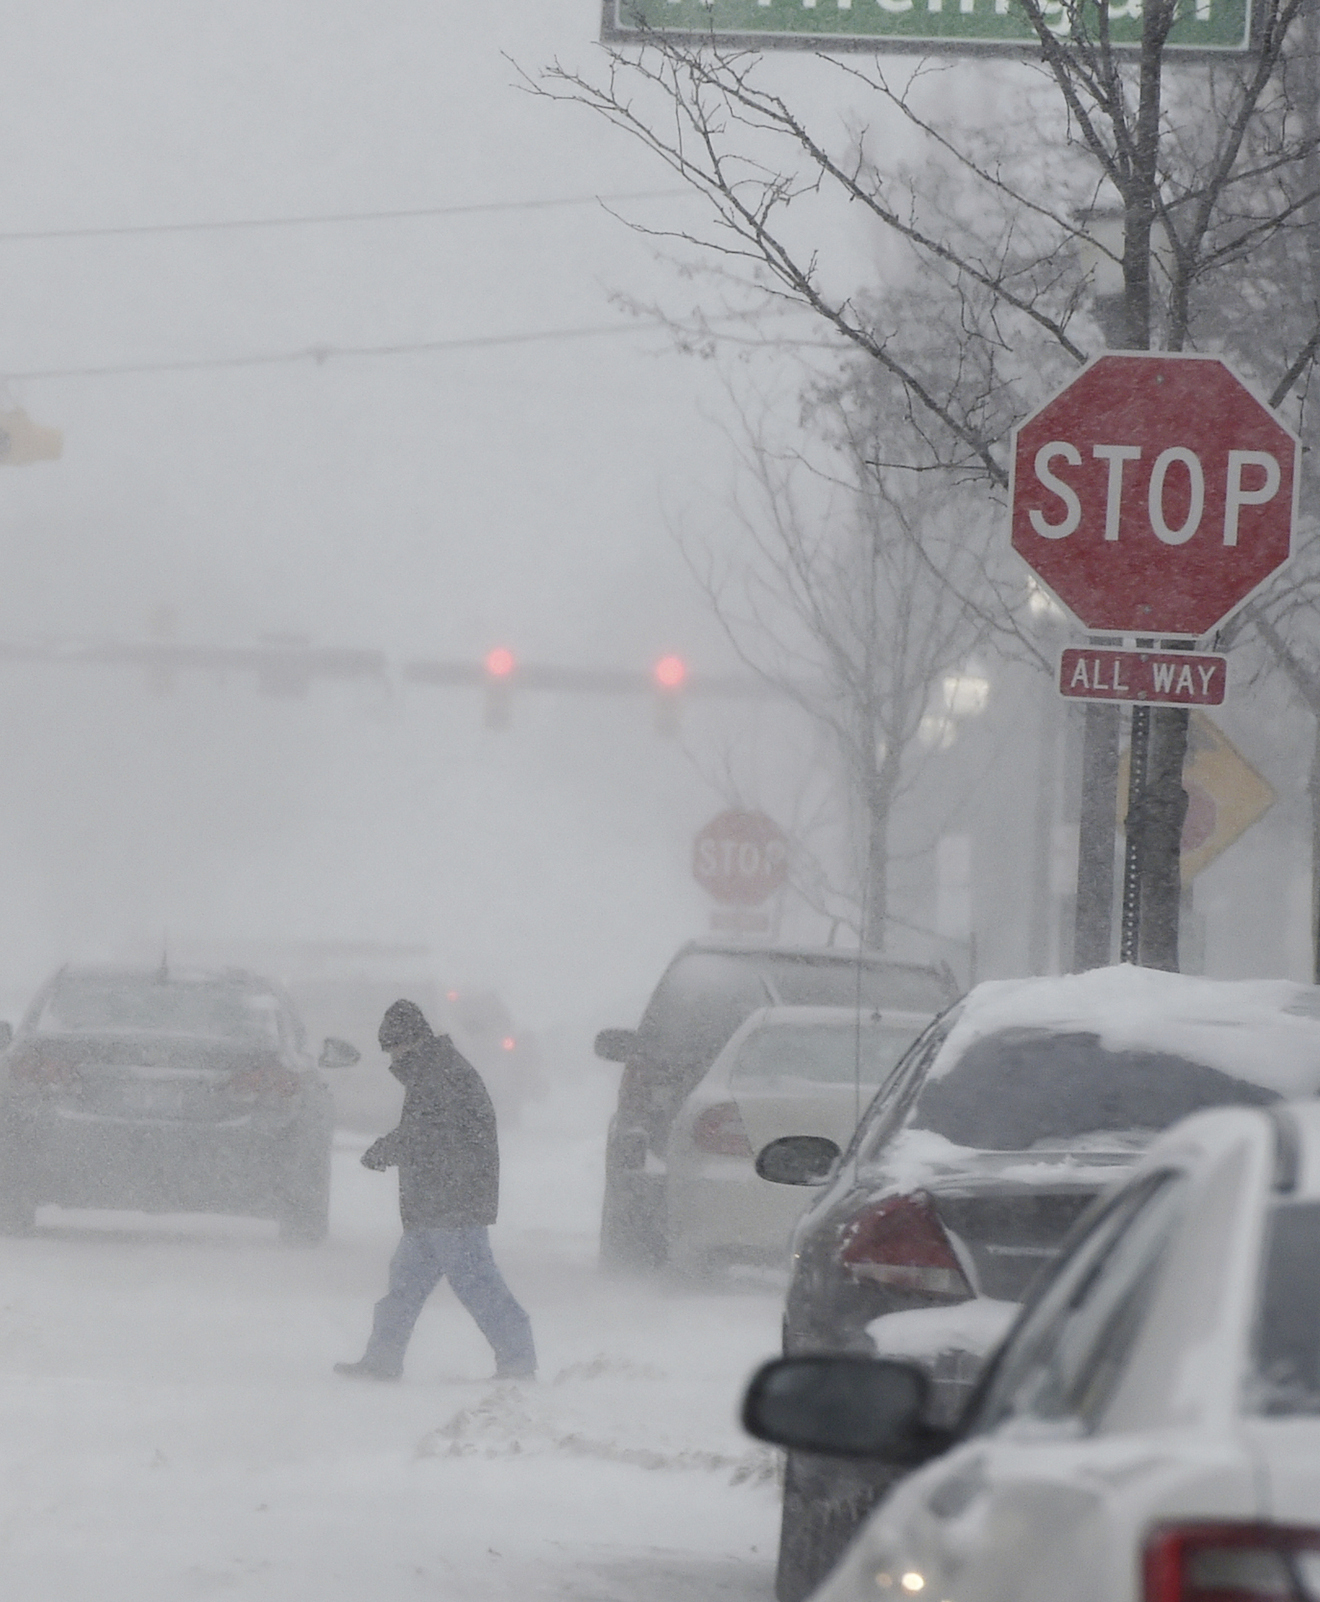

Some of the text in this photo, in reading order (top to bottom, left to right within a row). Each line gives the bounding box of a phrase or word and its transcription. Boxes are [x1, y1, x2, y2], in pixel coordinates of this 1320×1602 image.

[1029, 441, 1282, 547] STOP
[1070, 656, 1217, 695] ALL WAY
[698, 837, 785, 876] STOP
